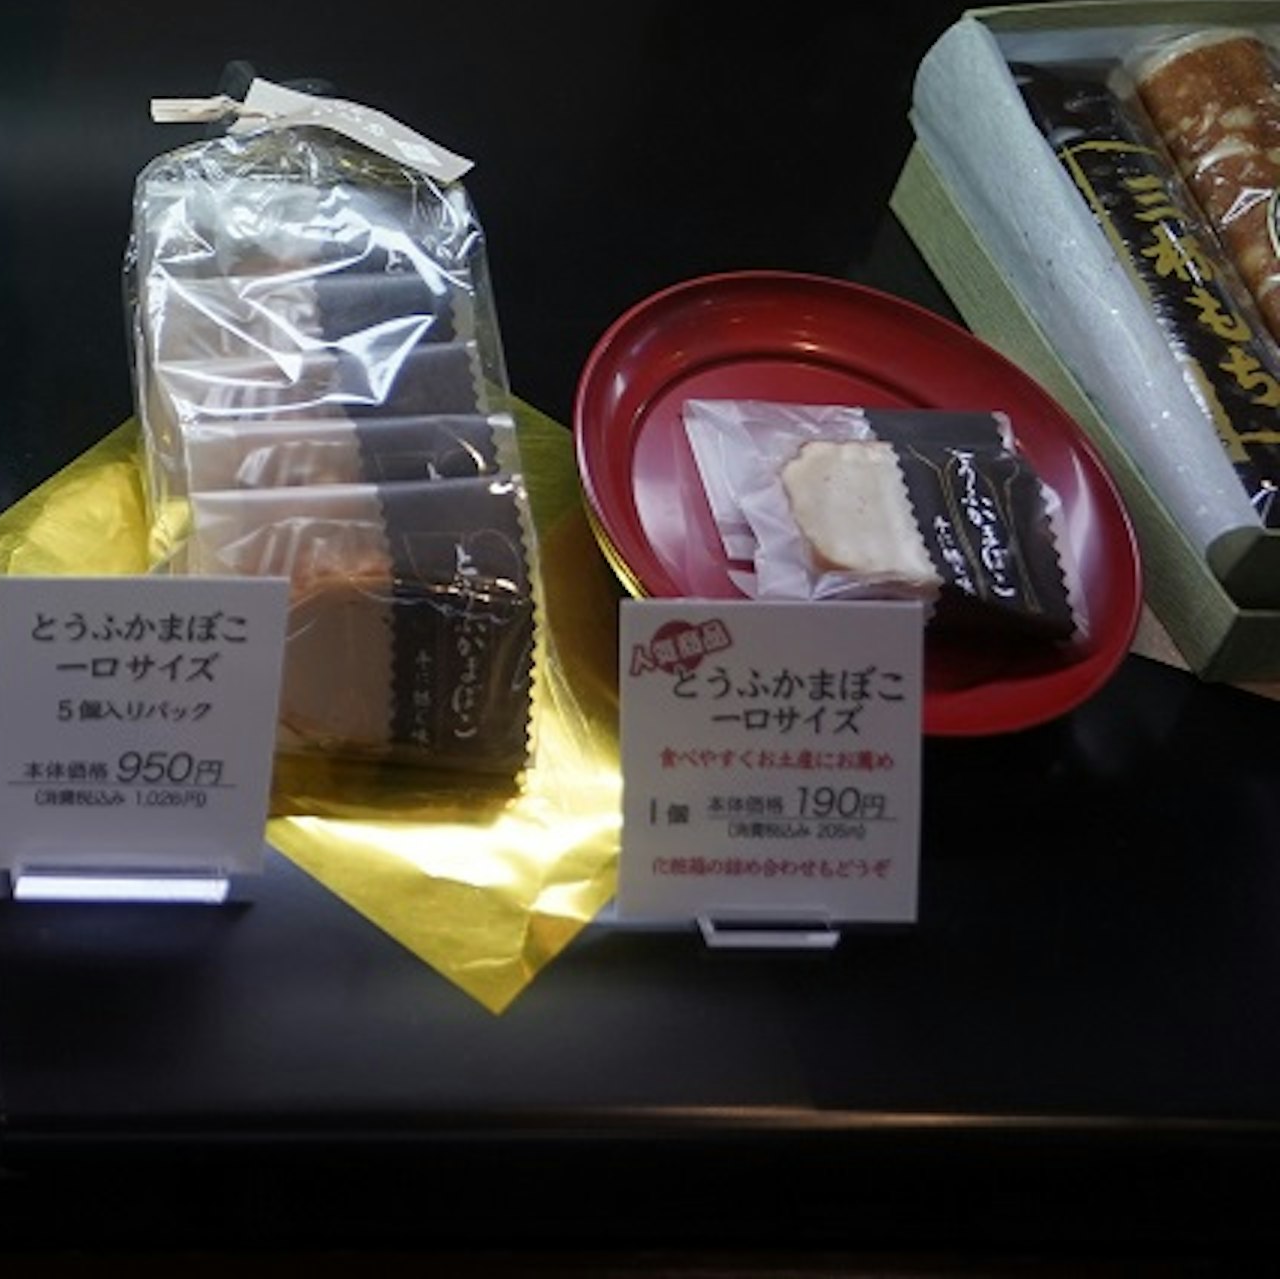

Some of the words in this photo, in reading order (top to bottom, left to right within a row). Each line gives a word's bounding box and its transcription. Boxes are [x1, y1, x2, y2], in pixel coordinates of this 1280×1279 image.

[31, 611, 248, 644] とうふかまぼこ
[56, 651, 221, 682] 一口サイズ
[672, 666, 905, 702] とうふかまぼこ
[57, 699, 213, 722] 5個入りパック
[711, 704, 864, 735] 一口サイズ
[23, 761, 109, 780] 本体価格
[114, 751, 225, 786] 950円
[707, 795, 783, 815] 本体価格
[796, 786, 886, 820] 190円
